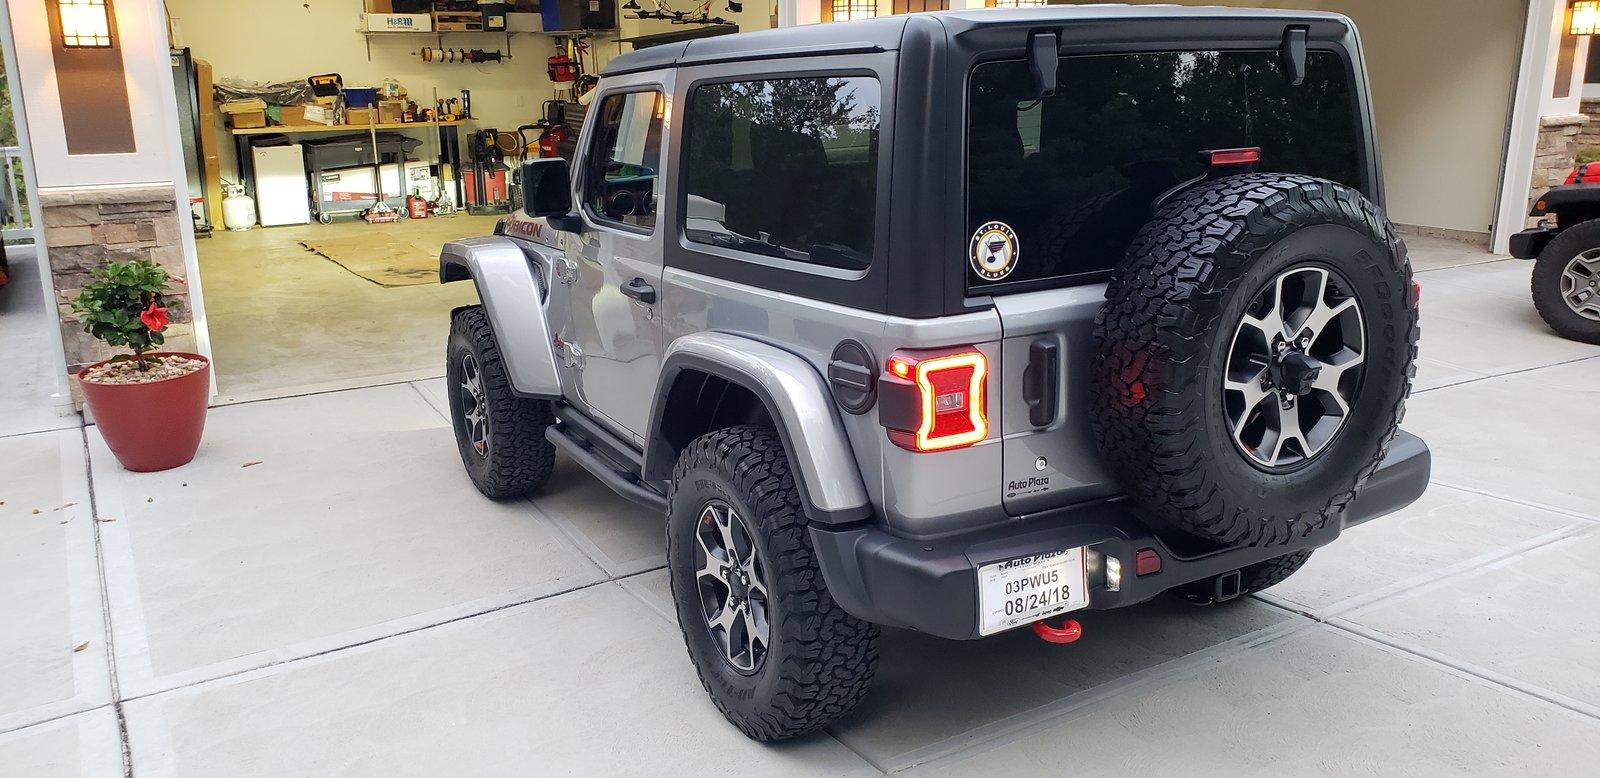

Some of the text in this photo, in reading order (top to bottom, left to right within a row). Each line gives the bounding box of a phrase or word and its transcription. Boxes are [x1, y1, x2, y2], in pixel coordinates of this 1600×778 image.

[988, 224, 1014, 239] LOUIS
[980, 266, 1010, 277] BLUES
[1008, 477, 1049, 491] Auto Plaza
[1004, 557, 1031, 570] Auto
[1033, 550, 1064, 563] Plaza
[1005, 570, 1059, 595] 03PWU5
[1005, 585, 1070, 616] 08/24/18
